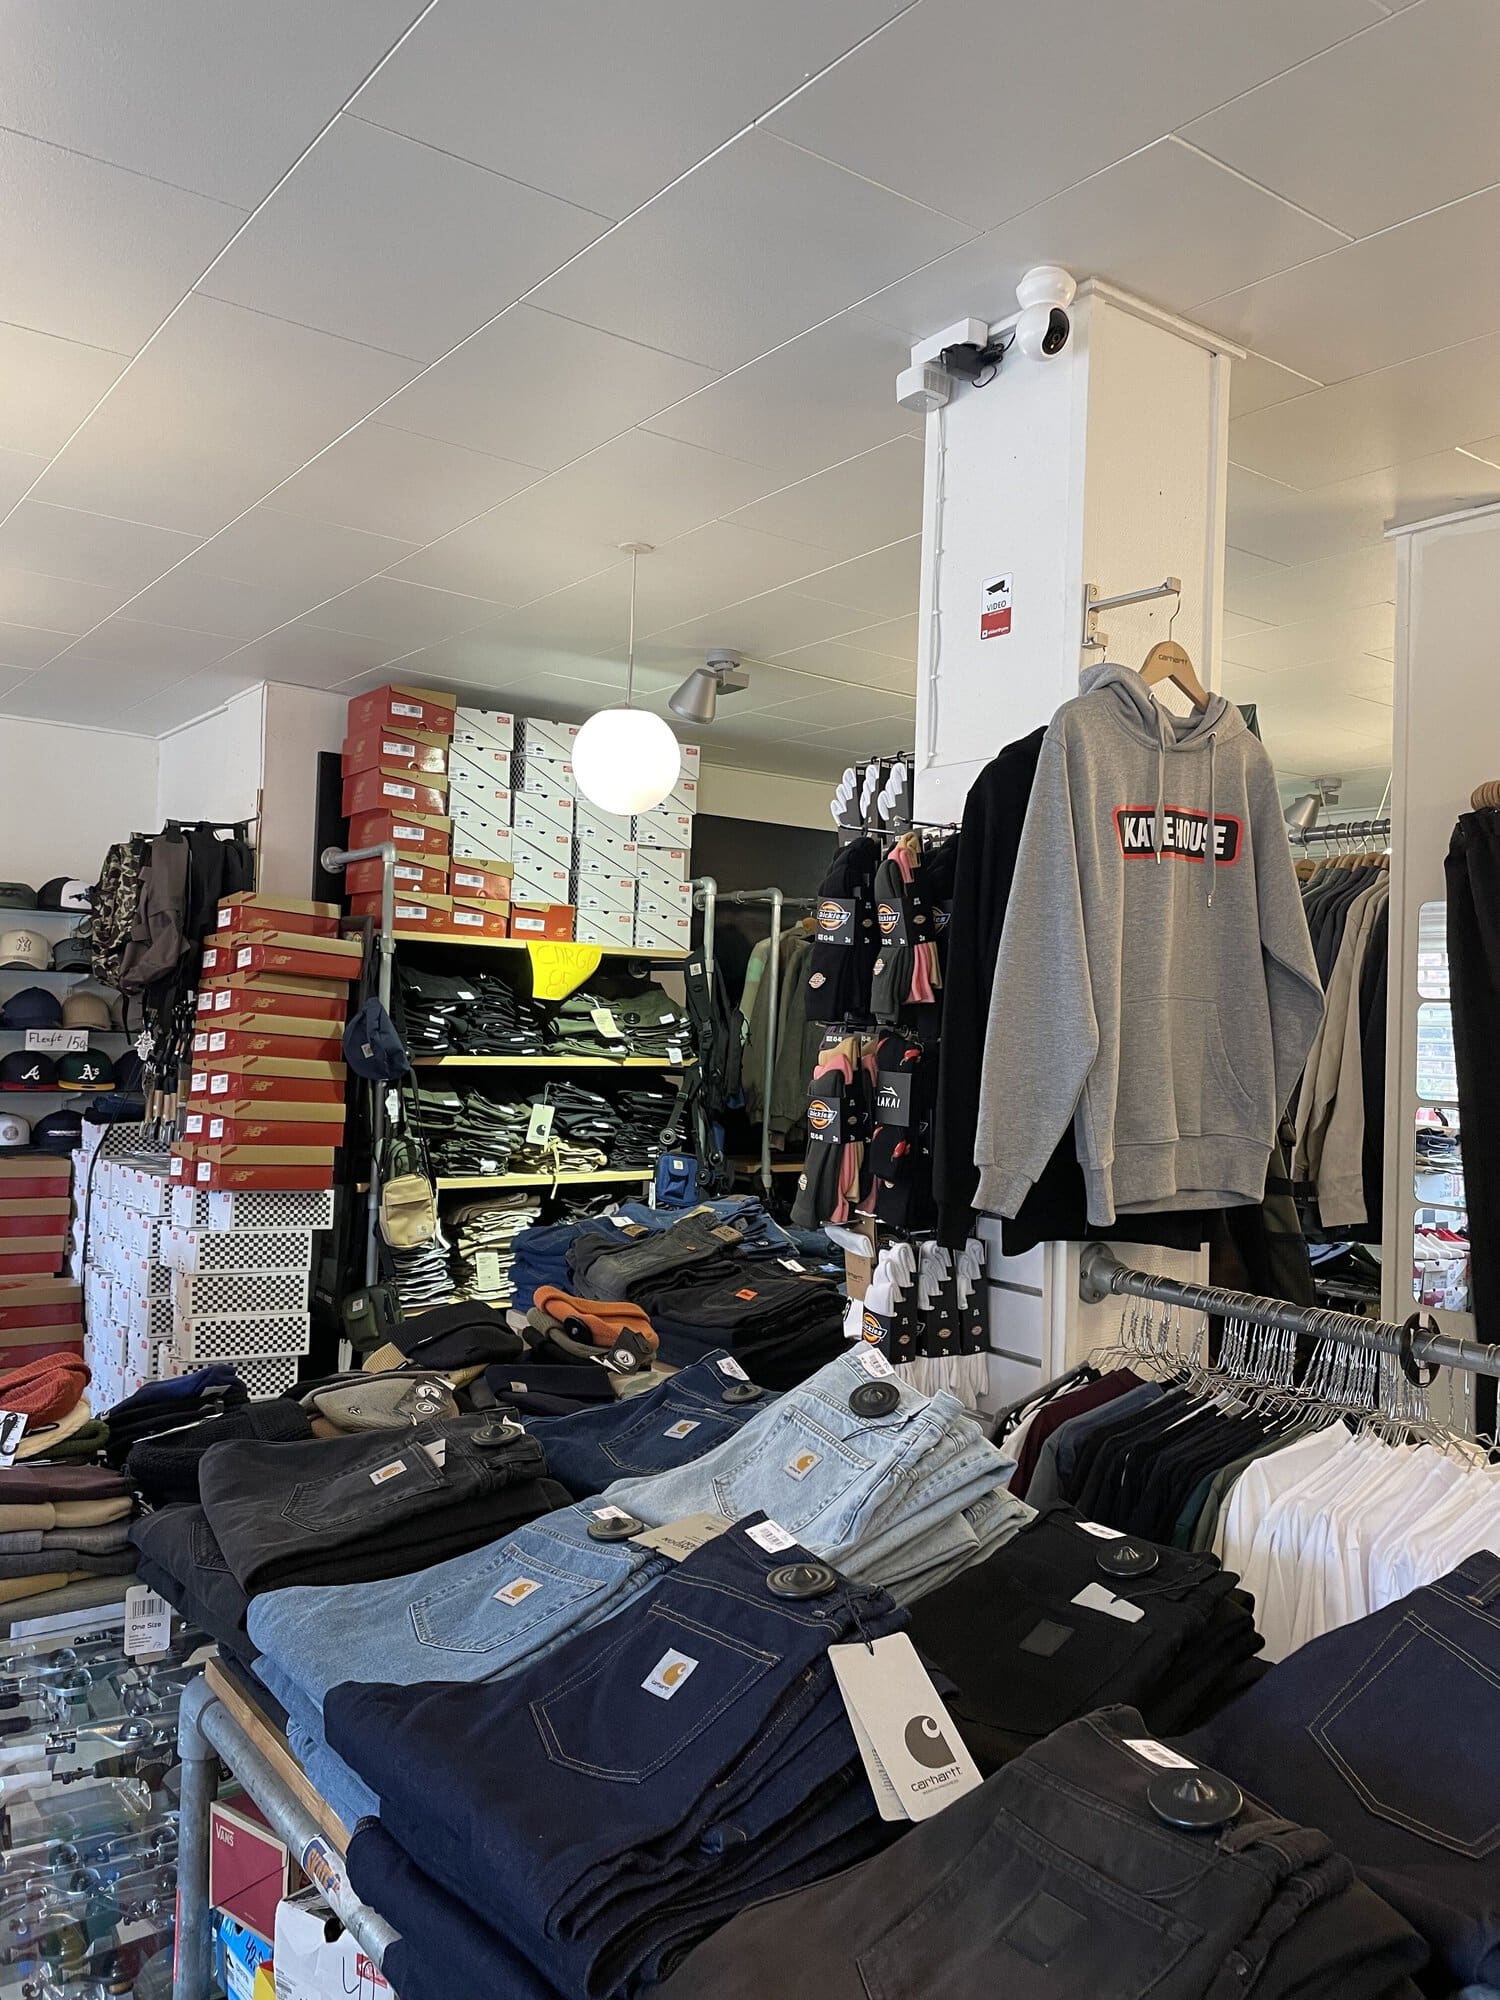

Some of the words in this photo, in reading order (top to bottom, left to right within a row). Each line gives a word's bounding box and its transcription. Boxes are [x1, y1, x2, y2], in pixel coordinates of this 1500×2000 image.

[986, 600, 1007, 612] VIDEO
[536, 945, 600, 971] CARGO
[21, 1064, 40, 1080] A
[77, 1063, 100, 1080] A's
[877, 1096, 900, 1109] LAKAI
[131, 1624, 146, 1632] One
[910, 1765, 963, 1792] carhartt
[215, 1822, 234, 1846] VANS
